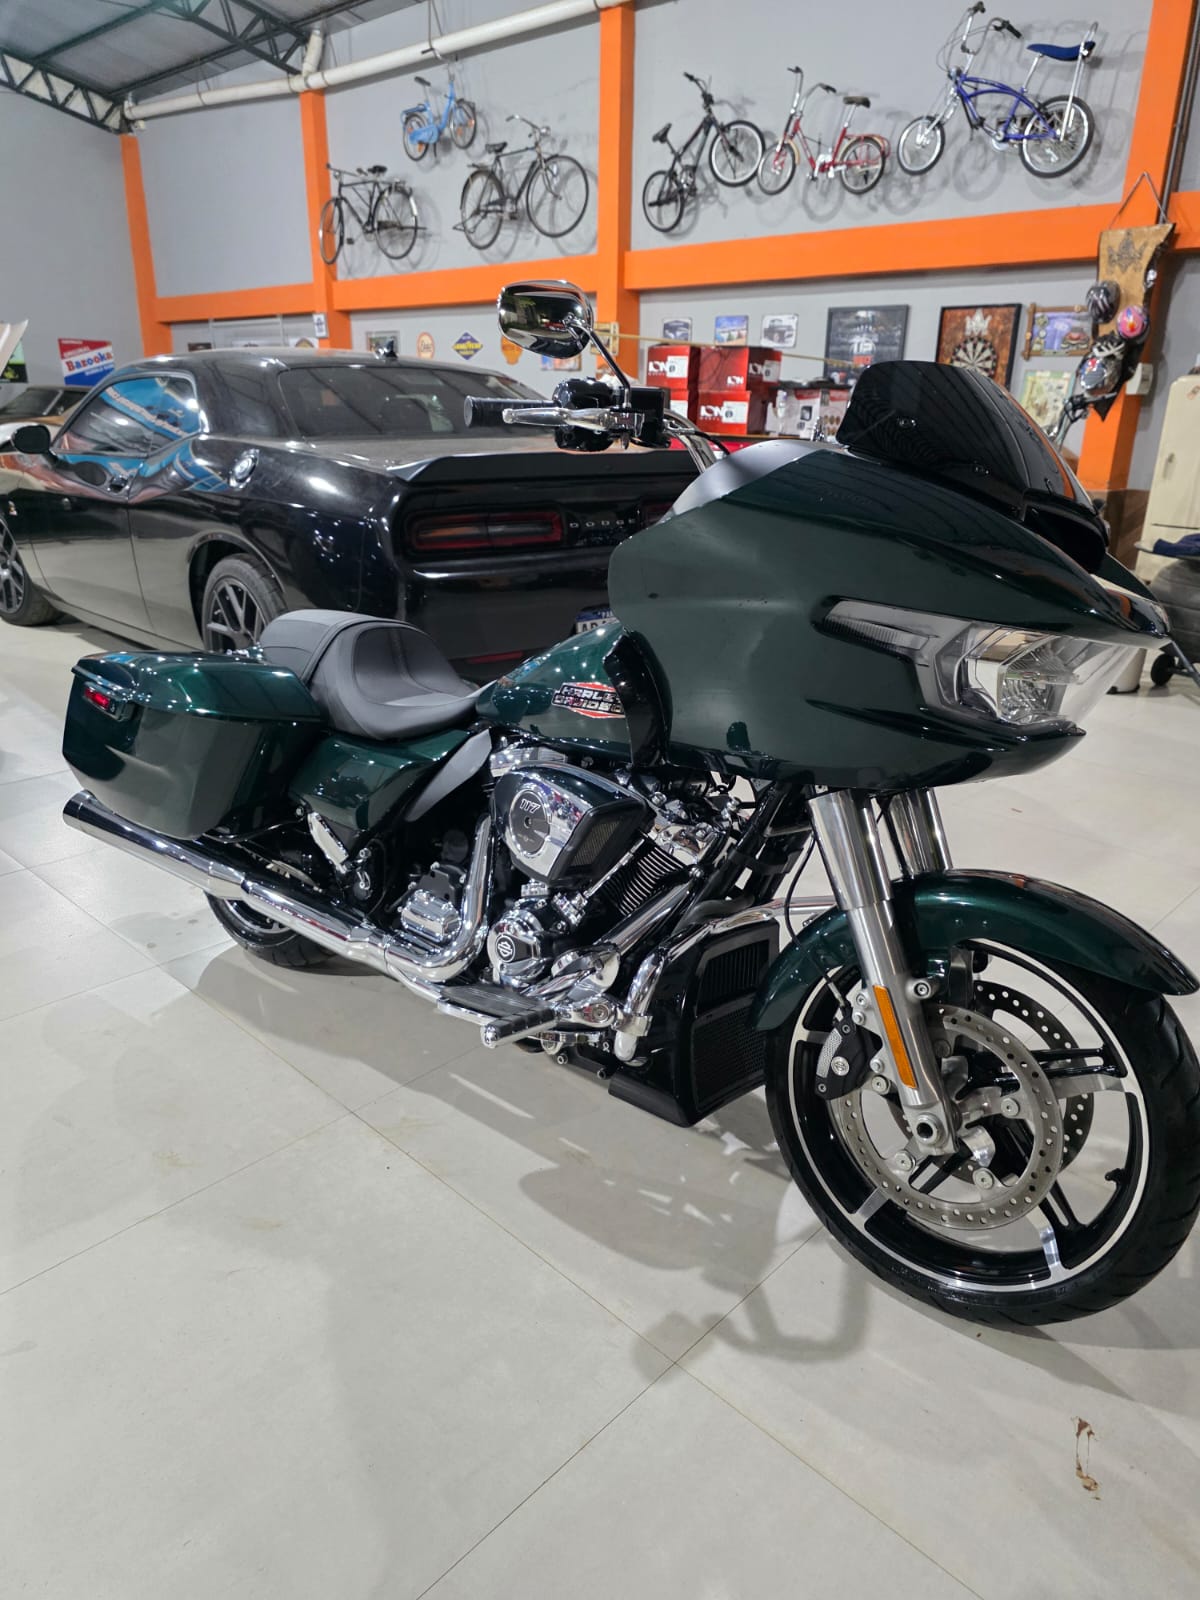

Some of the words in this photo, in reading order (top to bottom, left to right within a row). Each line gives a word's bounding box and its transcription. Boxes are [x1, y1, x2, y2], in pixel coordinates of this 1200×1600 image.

[569, 518, 635, 528] DODGE
[554, 694, 624, 713] DAVIDSO
[520, 798, 541, 814] 117
